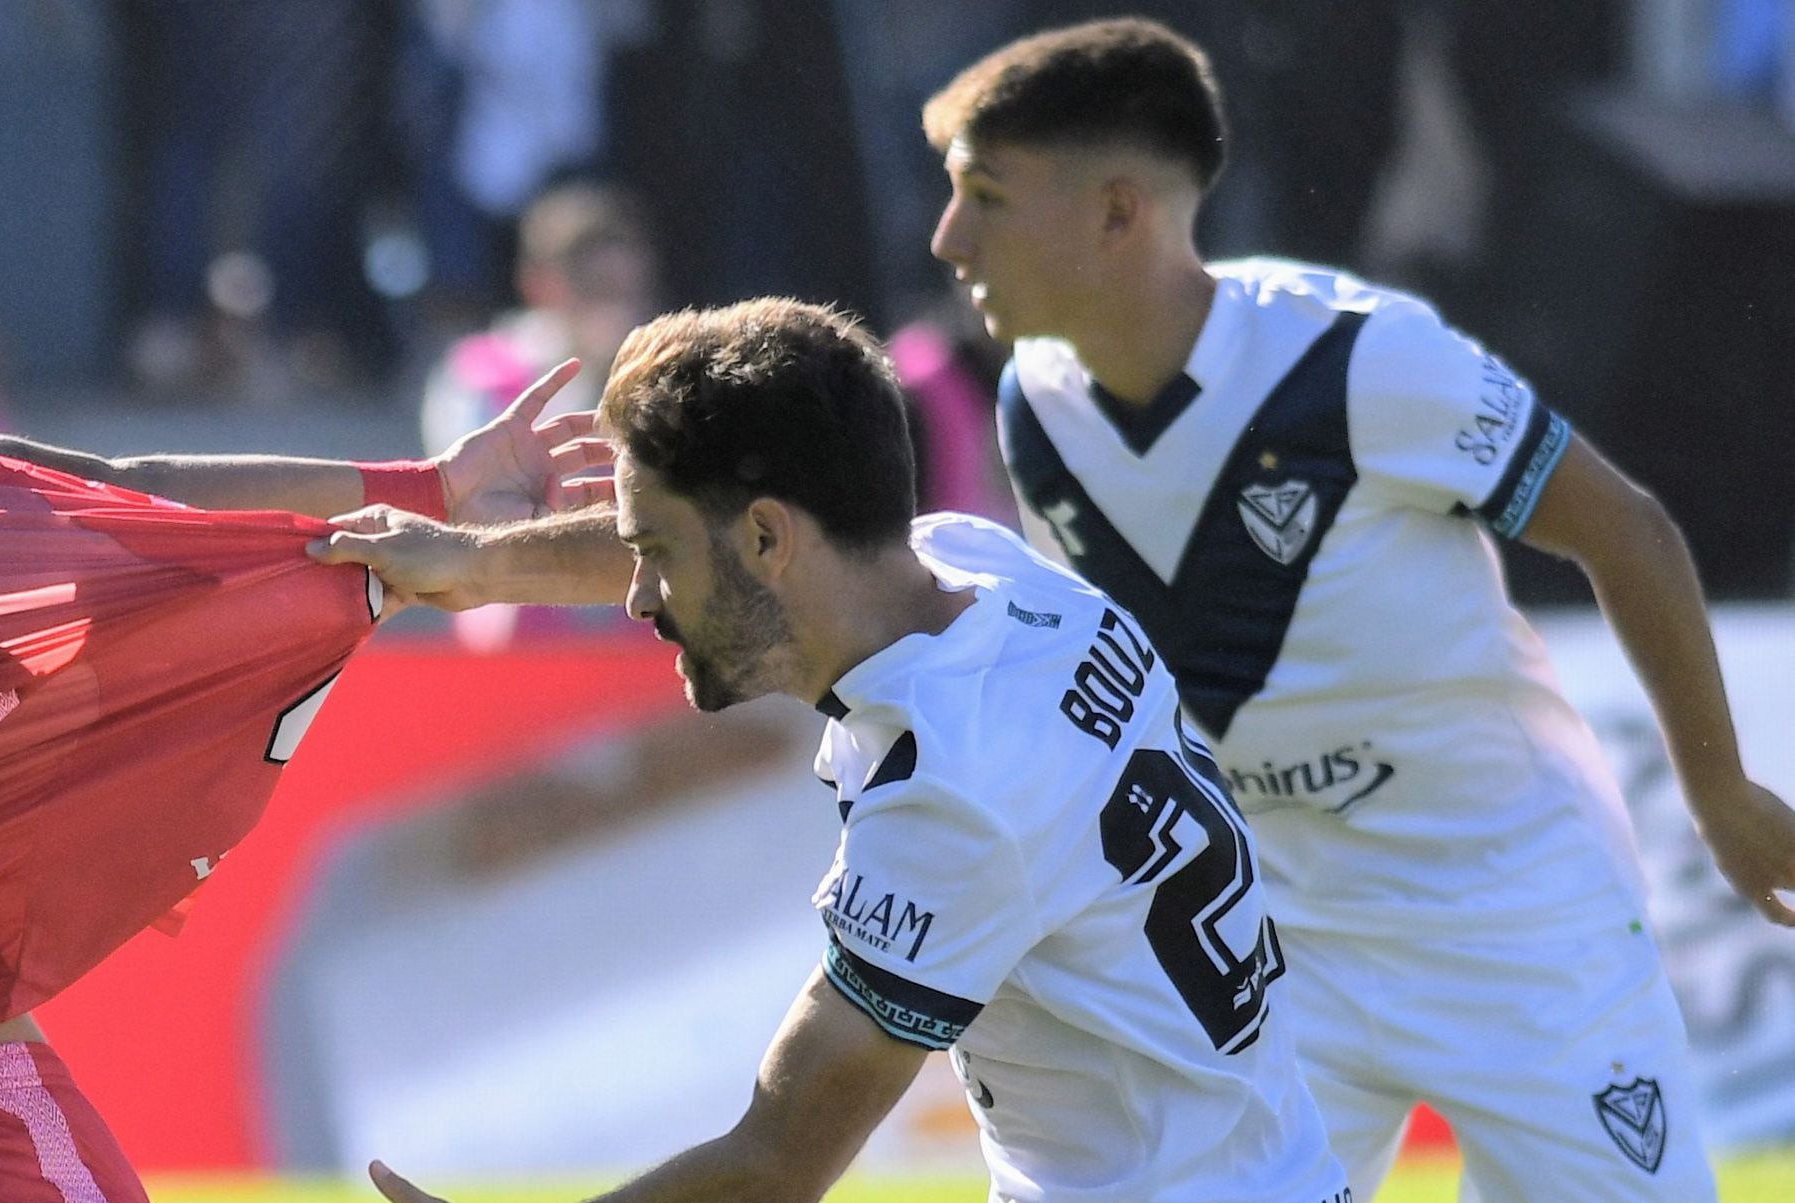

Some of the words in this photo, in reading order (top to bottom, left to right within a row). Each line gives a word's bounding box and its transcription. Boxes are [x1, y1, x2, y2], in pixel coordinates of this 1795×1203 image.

[1059, 607, 1155, 752] BOUZ
[1226, 745, 1359, 797] hirus
[830, 868, 936, 963] ALAM
[1099, 720, 1286, 1056] 2
[854, 927, 892, 953] MATE
